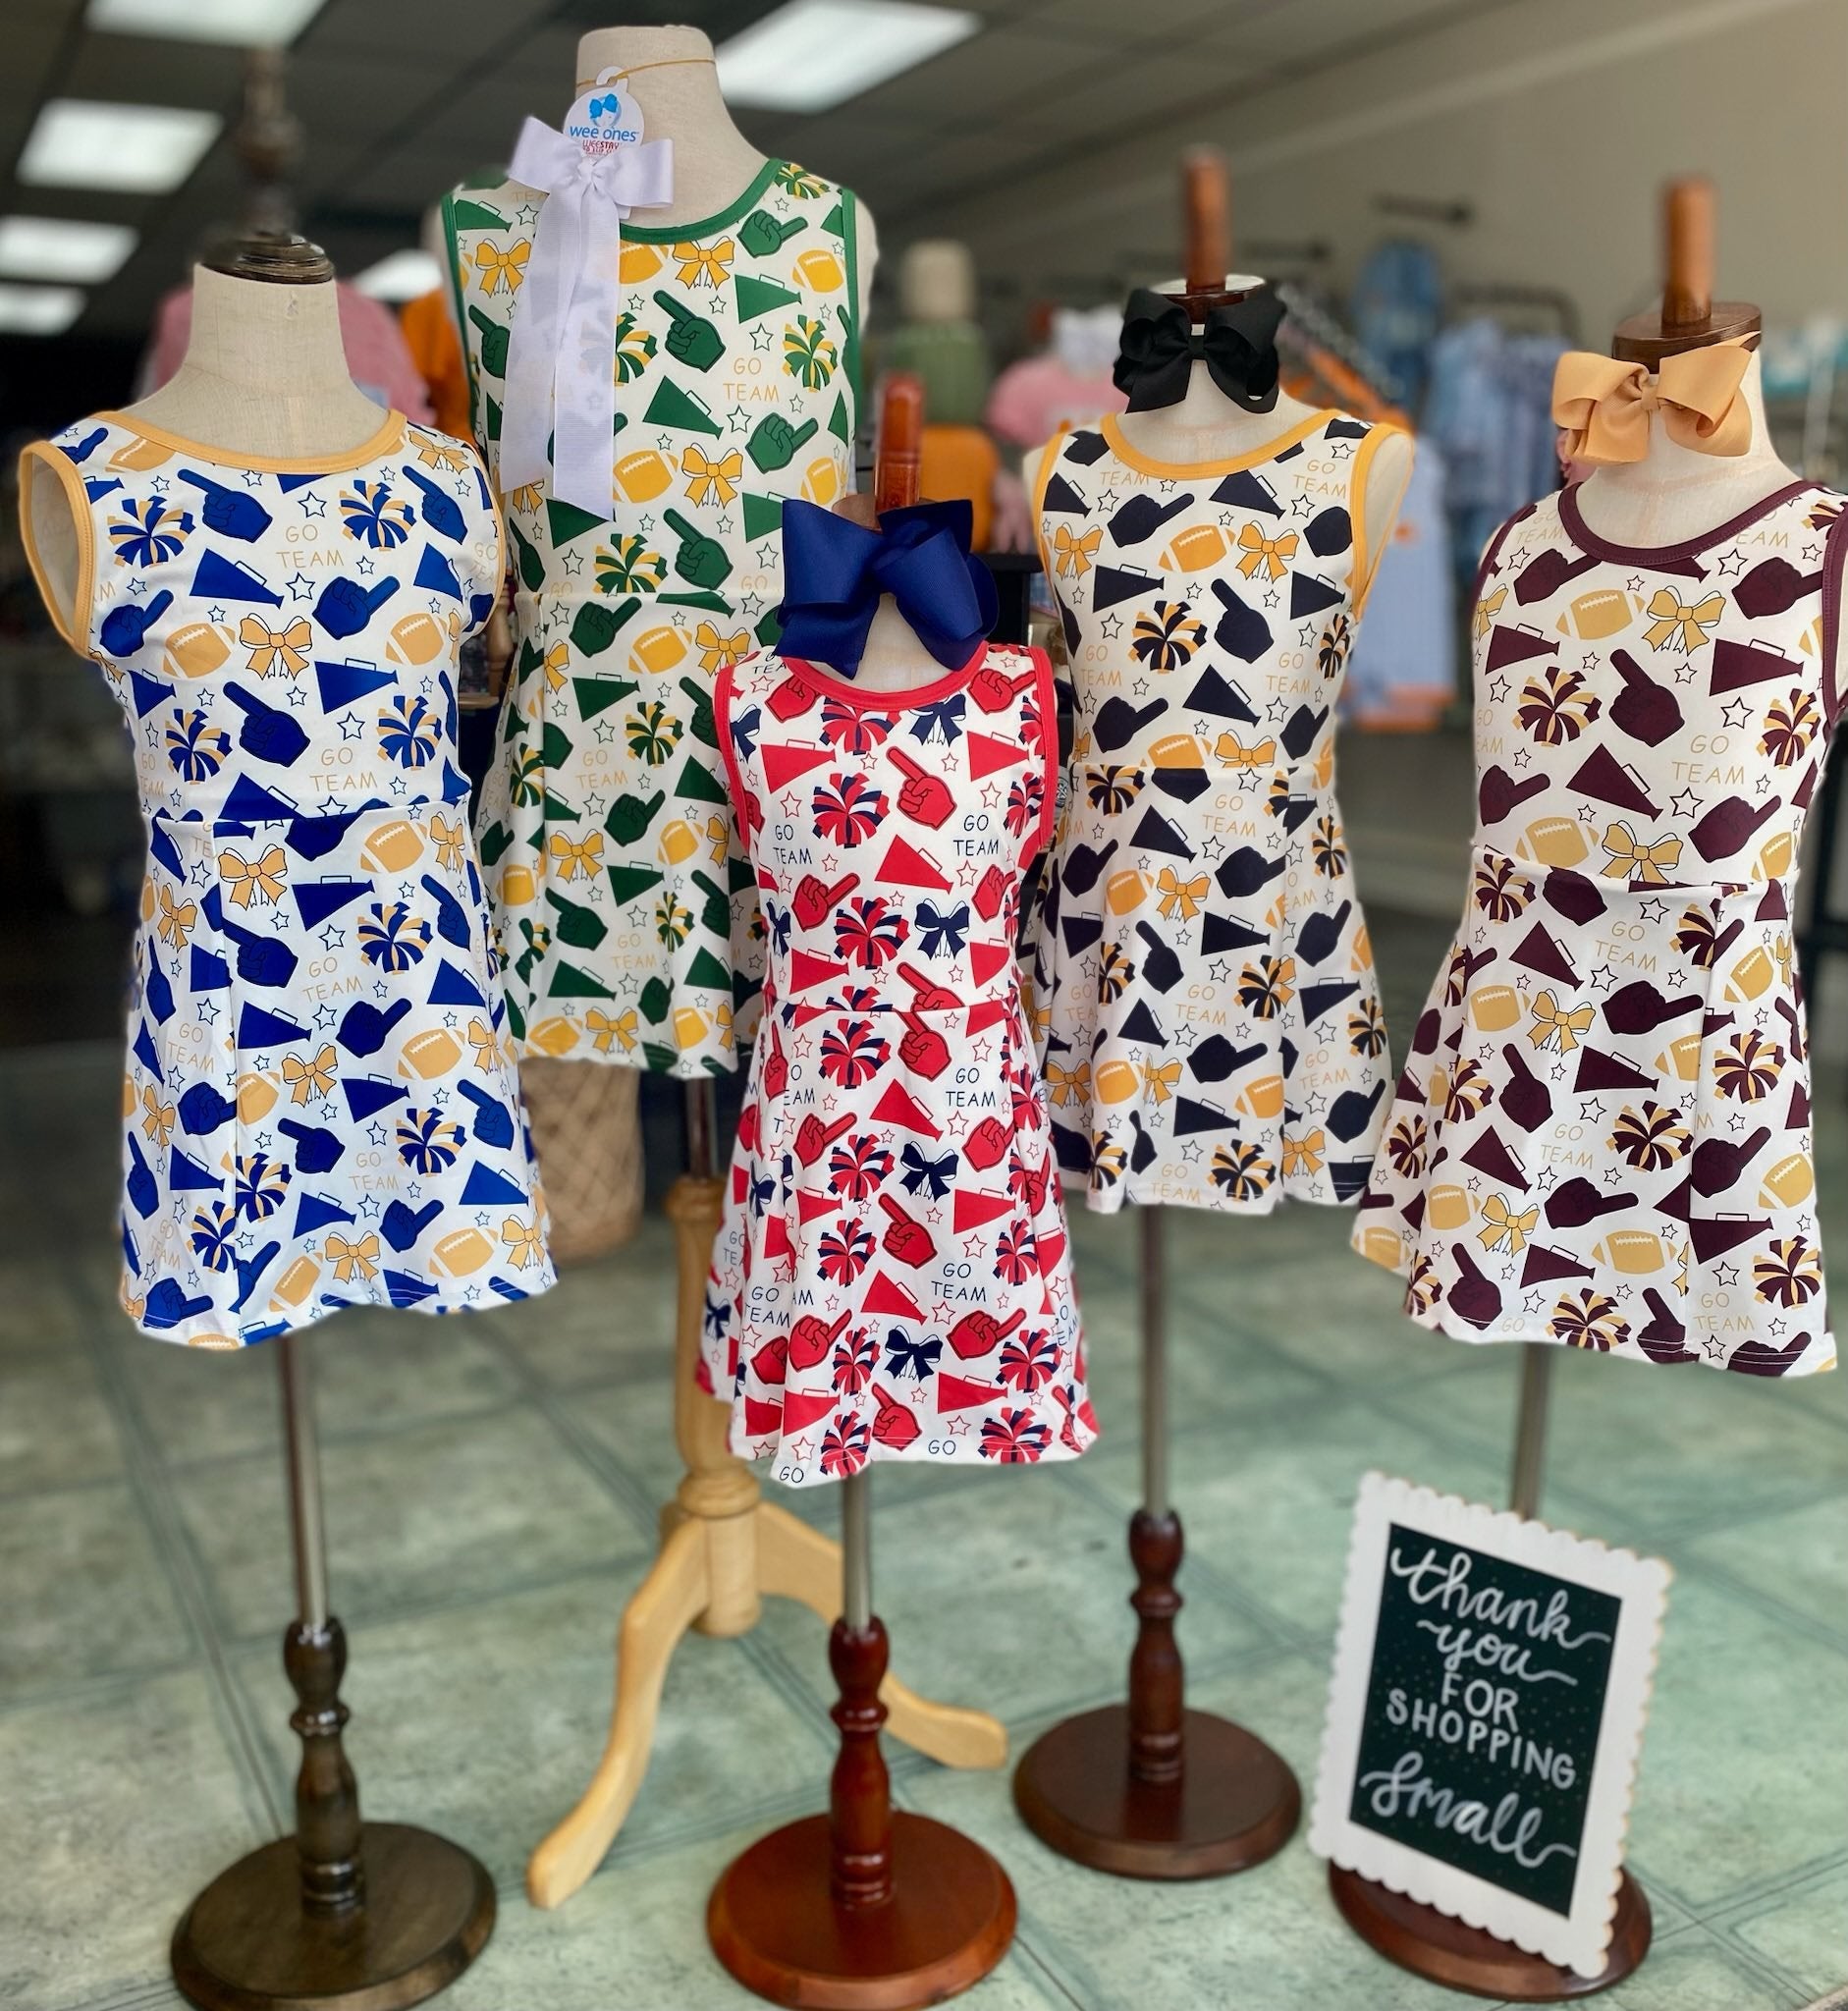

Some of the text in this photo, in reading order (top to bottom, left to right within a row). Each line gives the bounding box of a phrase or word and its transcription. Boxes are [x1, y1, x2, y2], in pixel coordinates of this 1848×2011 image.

[570, 126, 636, 141] wee ones
[734, 357, 761, 375] GO
[723, 383, 780, 403] TEAM
[1307, 460, 1335, 474] GO
[1100, 471, 1149, 485] TEAM
[1293, 473, 1346, 498] TEAM
[285, 524, 318, 542] GO
[1516, 527, 1563, 543] TEAM
[276, 549, 345, 569] TEAM
[474, 542, 498, 561] GO
[741, 575, 768, 590] GO
[1086, 645, 1108, 662] GO
[1279, 652, 1303, 669] GO
[753, 664, 787, 675] TEA
[1080, 669, 1121, 686] TEAM
[1265, 674, 1310, 694] TEAM
[1690, 734, 1729, 755] GO
[141, 754, 155, 771] GO
[321, 747, 353, 765] GO
[583, 750, 608, 766] GO
[309, 772, 378, 791] TEAM
[575, 771, 628, 788] TEAM
[1672, 761, 1745, 786] TEAM
[139, 775, 164, 796] TEAM
[1216, 793, 1242, 811] GO
[964, 814, 989, 832] GO
[1202, 814, 1255, 836] TEAM
[775, 825, 793, 841] GO
[191, 835, 211, 857] TE
[953, 839, 1000, 856] TEAM
[774, 846, 812, 865] TEAM
[1611, 920, 1646, 942] GO
[618, 934, 641, 949] GO
[612, 953, 657, 970] TEAM
[1595, 941, 1658, 973] TEAM
[309, 957, 338, 977] GO
[303, 975, 363, 1003] TEAM
[1070, 984, 1092, 1000] GO
[1187, 985, 1215, 1001] GO
[1064, 1006, 1095, 1022] TEA
[1175, 1003, 1227, 1026] TEAM
[180, 1023, 203, 1043] GO
[168, 1041, 214, 1073] TEAM
[1305, 1049, 1330, 1068] GO
[955, 1067, 980, 1084] GO
[1299, 1066, 1351, 1090] TEAM
[946, 1090, 996, 1107] TEAM
[1553, 1123, 1583, 1141] GO
[356, 1152, 381, 1168] GO
[1541, 1144, 1594, 1169] TEAM
[1161, 1163, 1188, 1179] GO
[349, 1174, 399, 1190] TEAM
[1150, 1181, 1201, 1203] TEAM
[160, 1220, 174, 1239] GO
[944, 1263, 971, 1278] GO
[751, 1286, 779, 1303] GO
[931, 1281, 987, 1302] TEAM
[1701, 1292, 1729, 1308] GO
[1501, 1318, 1525, 1332] GO
[1694, 1315, 1755, 1332] TEAM
[928, 1440, 956, 1455] GO
[779, 1467, 804, 1483] GO
[1389, 1547, 1611, 1650] thank
[1416, 1619, 1578, 1686] you
[1440, 1672, 1519, 1732] FOR
[1386, 1688, 1575, 1789] SHOPPING
